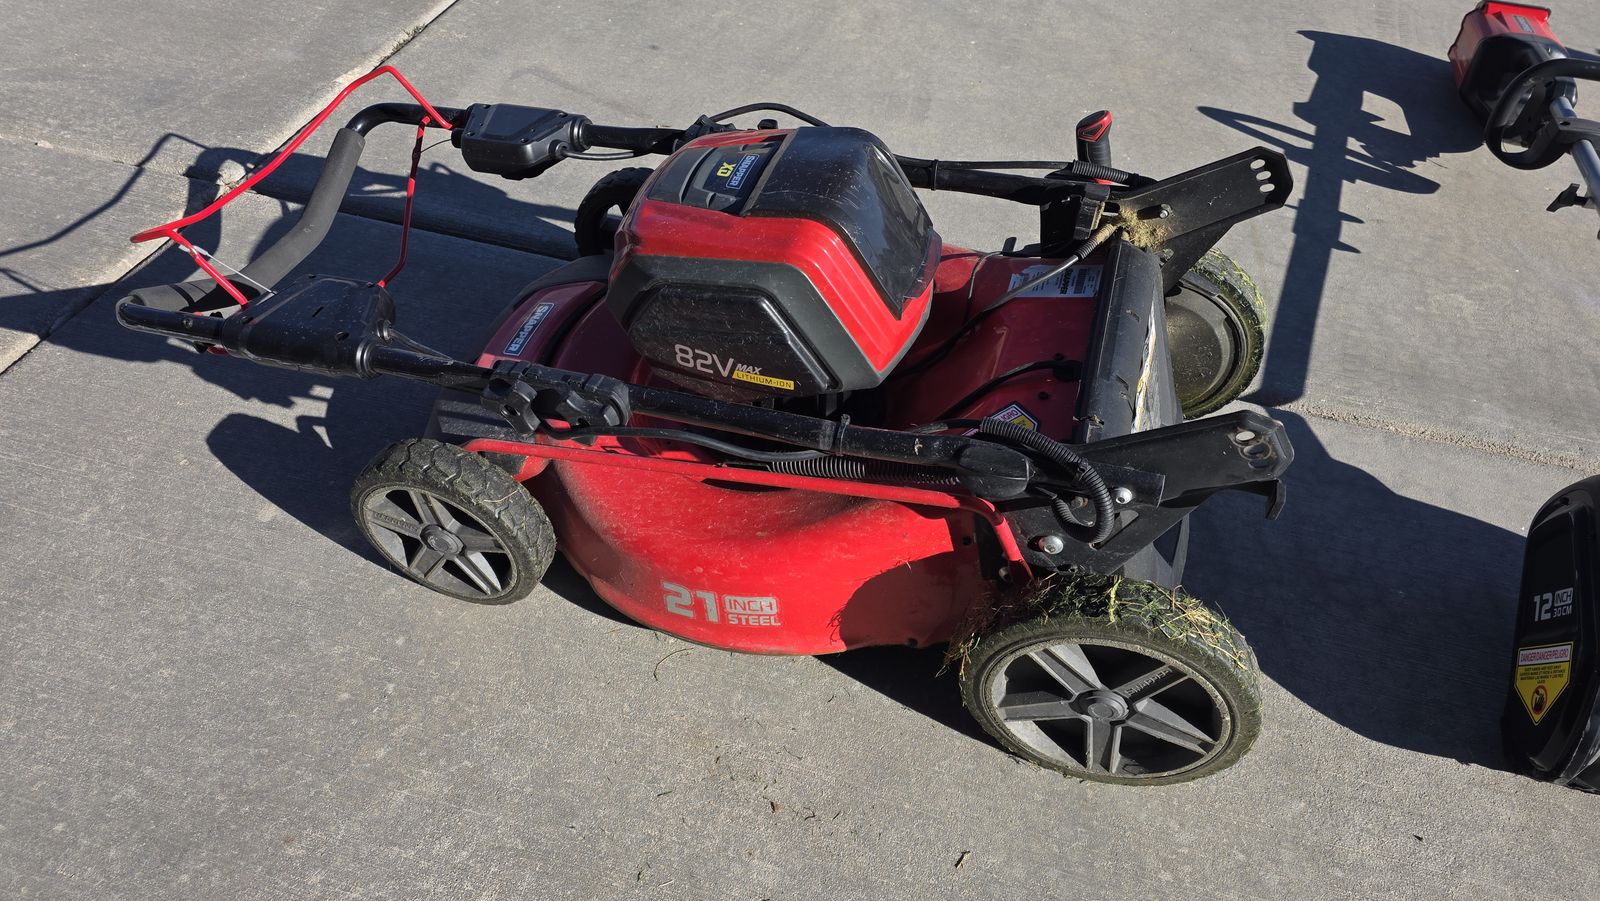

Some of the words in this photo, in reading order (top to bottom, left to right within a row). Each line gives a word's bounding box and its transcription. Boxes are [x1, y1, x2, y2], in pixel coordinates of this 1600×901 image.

[716, 162, 737, 177] XD
[729, 155, 756, 186] SNAPPER
[508, 305, 549, 351] SNAPPER
[674, 343, 734, 378] 82V
[735, 363, 762, 375] MAX
[736, 371, 792, 388] LITHIUM-ION
[662, 581, 718, 622] 21
[728, 598, 773, 613] INCH
[1534, 592, 1553, 622] 12
[1555, 589, 1572, 605] INCH
[728, 613, 781, 626] STEEL
